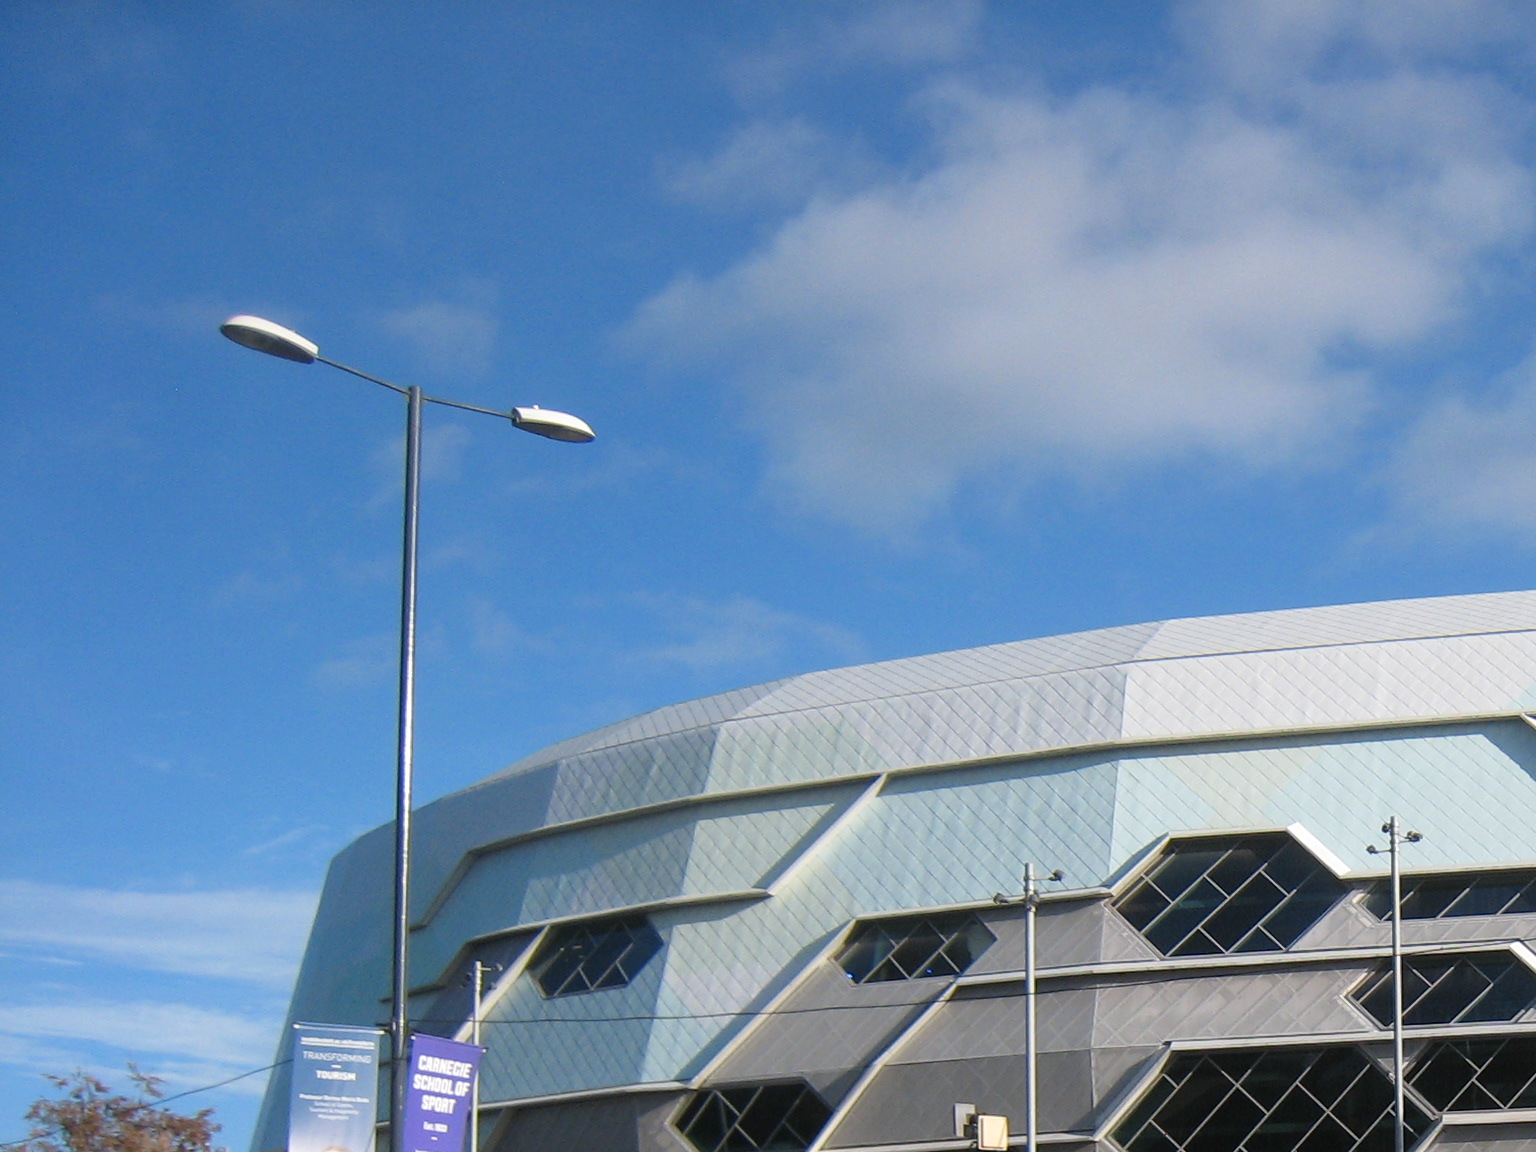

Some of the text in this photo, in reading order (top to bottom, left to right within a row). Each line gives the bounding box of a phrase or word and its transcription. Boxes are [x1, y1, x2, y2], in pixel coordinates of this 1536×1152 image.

[303, 1050, 372, 1064] TRANSFORMING
[418, 1055, 472, 1078] CARNEGIE
[315, 1070, 356, 1081] TOURISM
[413, 1074, 470, 1097] SCHOOL OF
[421, 1095, 456, 1114] SPORT
